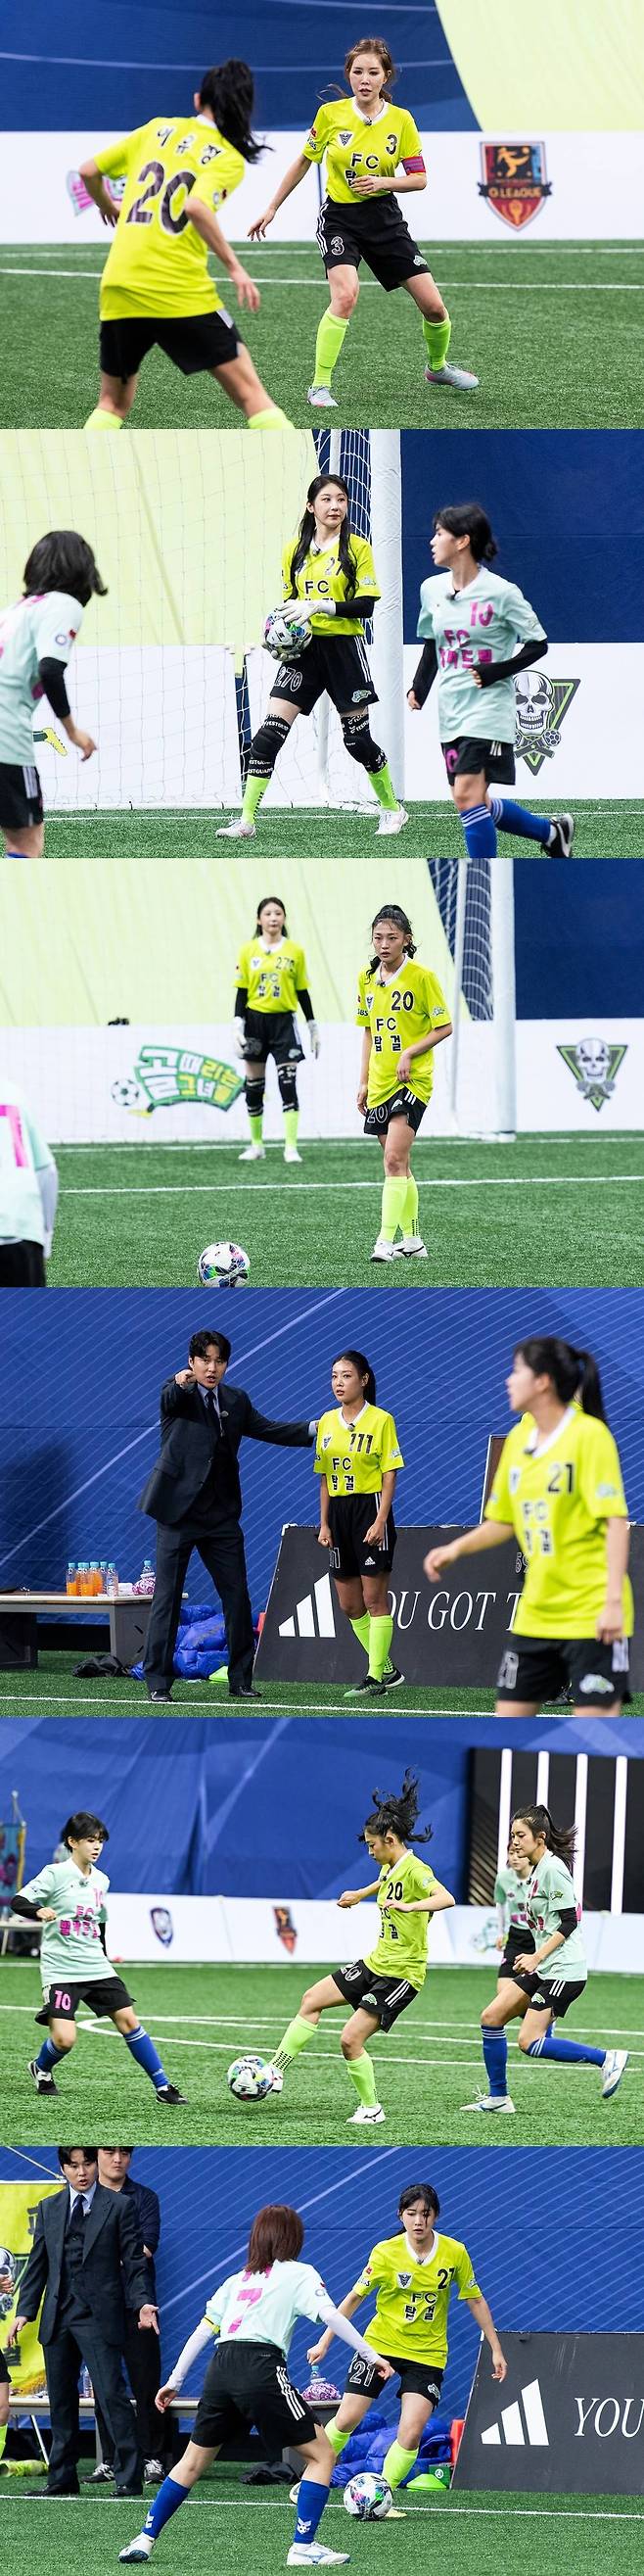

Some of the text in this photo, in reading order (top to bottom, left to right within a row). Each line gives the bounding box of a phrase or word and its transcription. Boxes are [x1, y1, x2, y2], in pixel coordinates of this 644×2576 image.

[385, 133, 398, 156] 3
[350, 152, 380, 169] FC
[125, 160, 198, 235] 20
[330, 235, 345, 256] 3
[304, 580, 330, 595] FC
[469, 600, 495, 628] 10
[442, 629, 472, 650] FC
[273, 665, 303, 692] 270
[391, 990, 415, 1012] 20
[375, 1018, 397, 1031] FC
[366, 1104, 389, 1124] 20
[332, 1456, 352, 1470] FC
[546, 1463, 575, 1494] 21
[427, 1590, 497, 1631] GOT
[386, 1881, 403, 1901] 20
[54, 1989, 71, 2011] 10
[411, 2292, 437, 2304] FC
[227, 2287, 263, 2334] 7
[348, 2361, 377, 2387] 21
[573, 2397, 644, 2439] YOU
